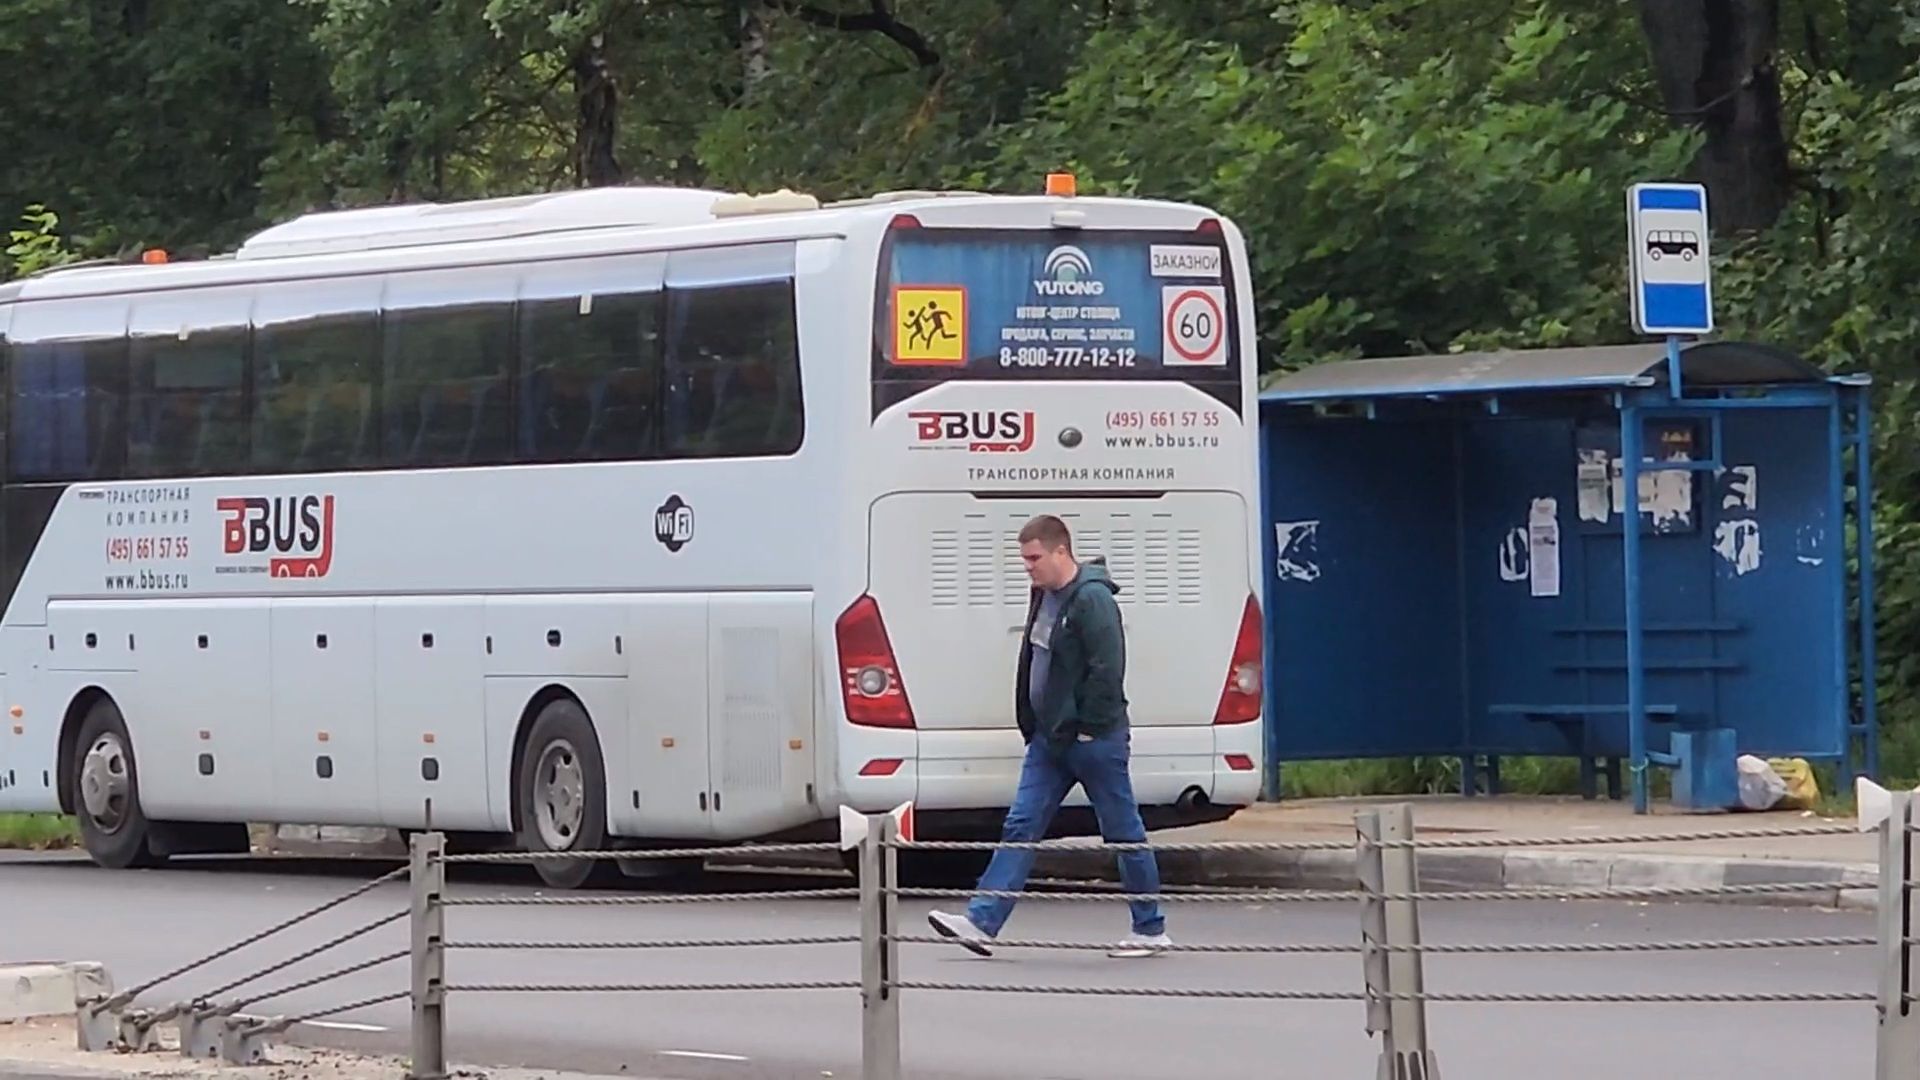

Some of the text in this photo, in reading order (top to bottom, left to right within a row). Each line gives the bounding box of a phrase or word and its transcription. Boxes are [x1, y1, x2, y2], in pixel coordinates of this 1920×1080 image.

[1153, 254, 1219, 270] ЗАКАЗНОЙ
[1034, 280, 1104, 295] YUTONG
[1180, 312, 1211, 339] 60
[1000, 347, 1136, 367] 8-800-777-12-12
[1106, 411, 1220, 430] (495) 661 57 55
[1105, 433, 1220, 448] www.bbus.ru
[968, 467, 1175, 481] ТРАНСПОРТНАЯ КОМПАНИЯ
[107, 487, 190, 504] ТРАНСПОРТНАЯ
[106, 509, 189, 526] КОМПАНИЯ
[106, 536, 189, 564] (495) 661 57 55
[105, 568, 188, 589] www.bbus.ru
